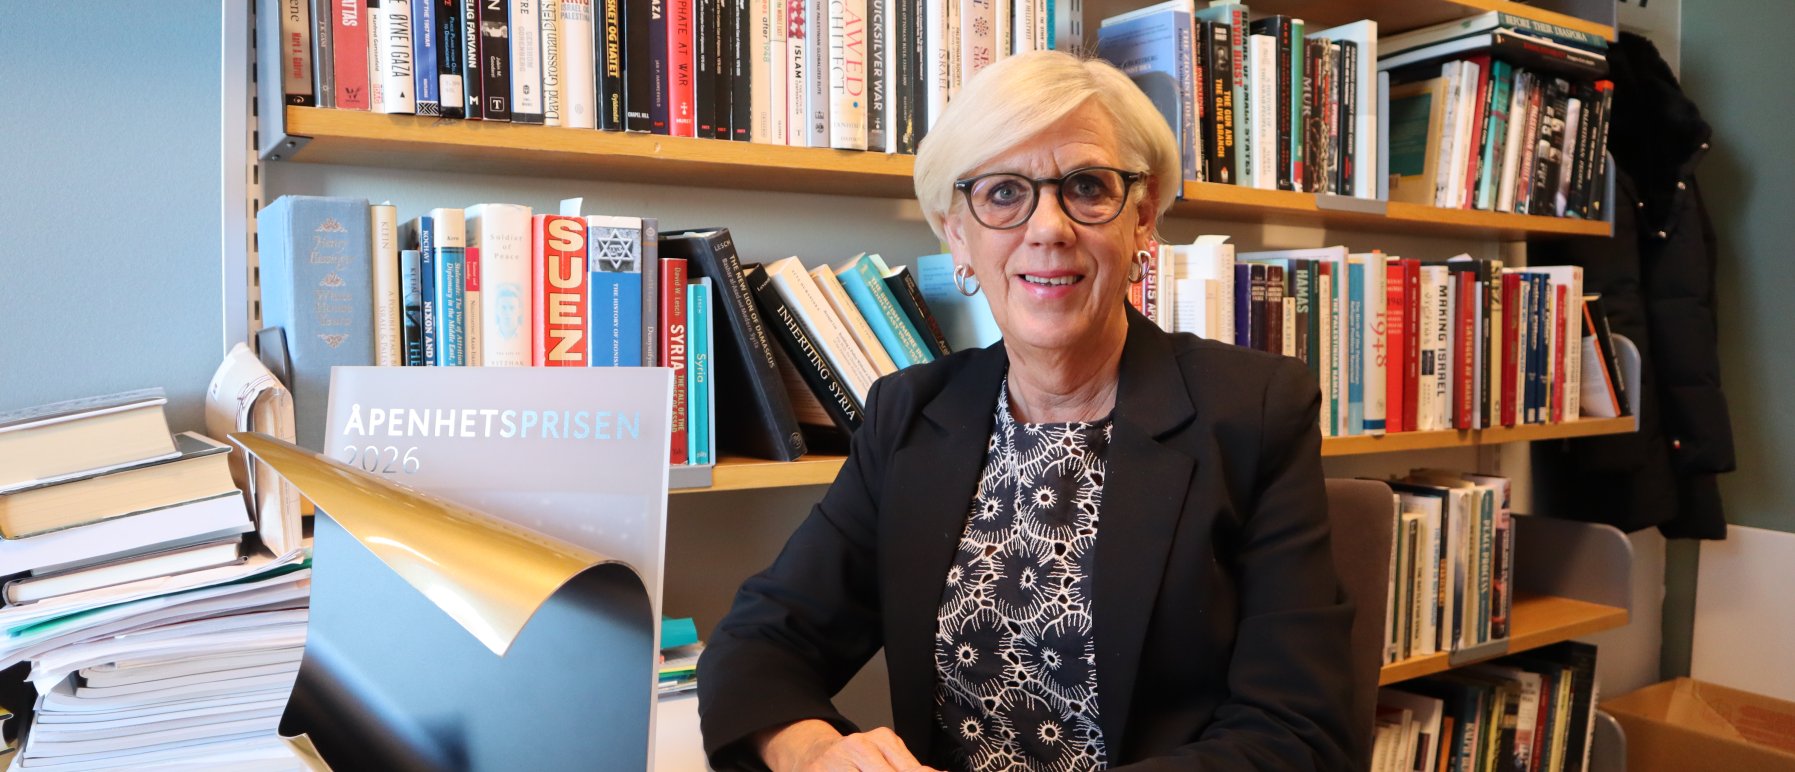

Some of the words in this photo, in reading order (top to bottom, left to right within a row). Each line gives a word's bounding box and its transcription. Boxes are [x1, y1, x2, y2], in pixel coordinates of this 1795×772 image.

[390, 14, 408, 40] ØYNE
[609, 26, 617, 41] OG
[677, 1, 687, 33] PHATE
[1233, 10, 1241, 46] DAVID
[1505, 14, 1532, 29] BEFORE
[1533, 19, 1553, 34] THEIR
[1554, 25, 1587, 41] DIASPORA
[467, 22, 476, 68] FARVANN
[544, 33, 559, 86] Grossman
[609, 43, 619, 77] HATET
[679, 42, 687, 55] AT
[392, 52, 409, 77] GAZA
[679, 64, 688, 86] WAR
[1233, 50, 1242, 87] HIRST
[545, 90, 559, 120] David
[874, 78, 882, 110] WAR
[1303, 77, 1312, 116] MUR
[381, 222, 389, 249] KLEIN
[490, 233, 523, 241] Soldier
[714, 240, 730, 252] LESCH
[548, 218, 583, 361] SUEZ
[1297, 270, 1308, 313] HAMAS
[1491, 266, 1499, 305] SUEZ
[424, 301, 432, 334] NIXON
[721, 257, 732, 278] Bashar
[749, 332, 760, 350] Syria
[729, 254, 739, 271] THE
[735, 271, 747, 291] NEW
[743, 292, 753, 312] LION
[750, 310, 760, 324] OF
[755, 324, 775, 369] DAMASCUS
[870, 276, 882, 291] THE
[880, 291, 901, 321] BRITISH
[898, 321, 918, 348] EMPIRE
[1439, 285, 1447, 341] MAKING
[614, 329, 618, 337] OF
[670, 324, 684, 369] SYRIA
[1370, 312, 1386, 367] 1948
[695, 353, 706, 383] Syria
[776, 302, 830, 381] INHERITING
[828, 381, 856, 420] SYRIA
[1437, 348, 1446, 397] ISRAEL
[1466, 366, 1472, 376] AV
[343, 404, 640, 440] ÅPENHETSPRISEN
[678, 405, 684, 414] OF
[344, 445, 420, 474] 2026
[1481, 552, 1490, 593] PROCESS
